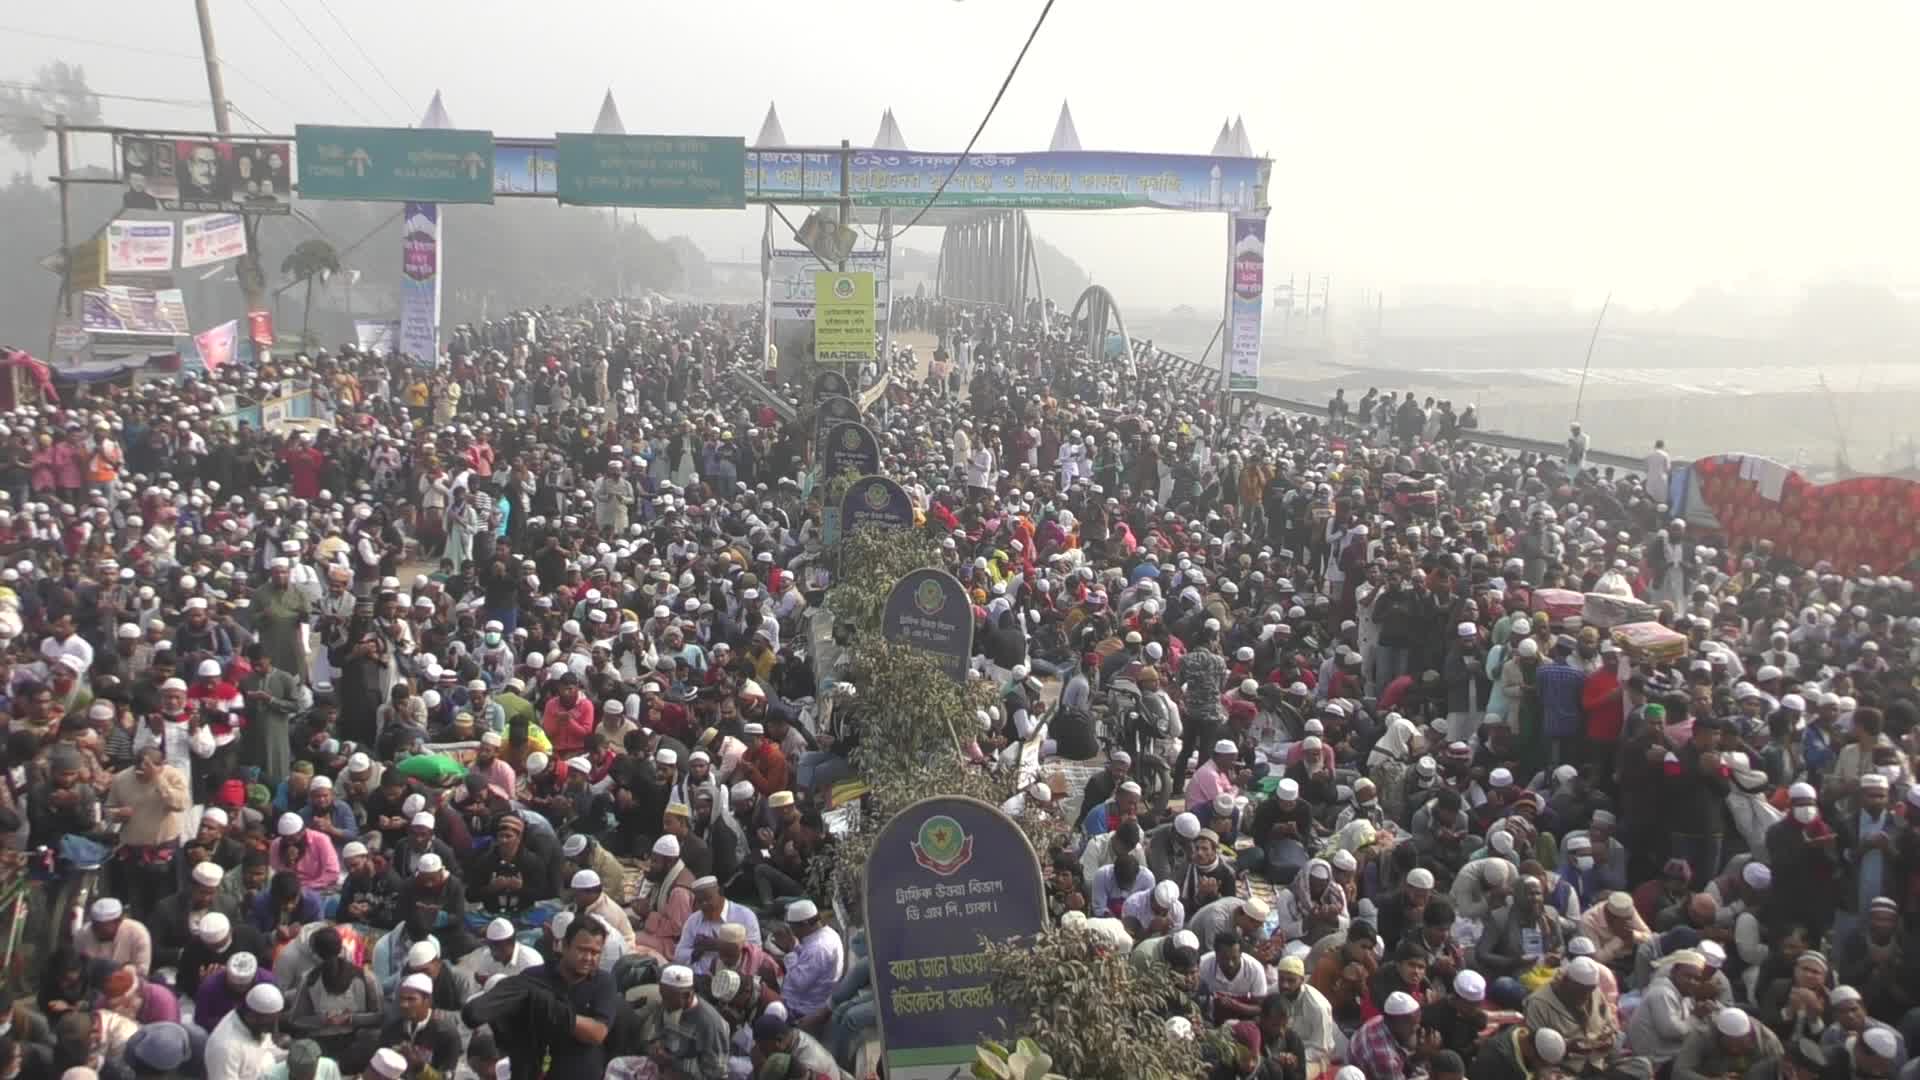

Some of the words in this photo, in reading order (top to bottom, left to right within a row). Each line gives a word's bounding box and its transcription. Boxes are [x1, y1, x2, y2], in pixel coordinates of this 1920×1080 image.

[819, 351, 871, 360] MARCEL
[895, 885, 932, 904] ট্রাফিক
[968, 879, 1003, 895] বিভাগ
